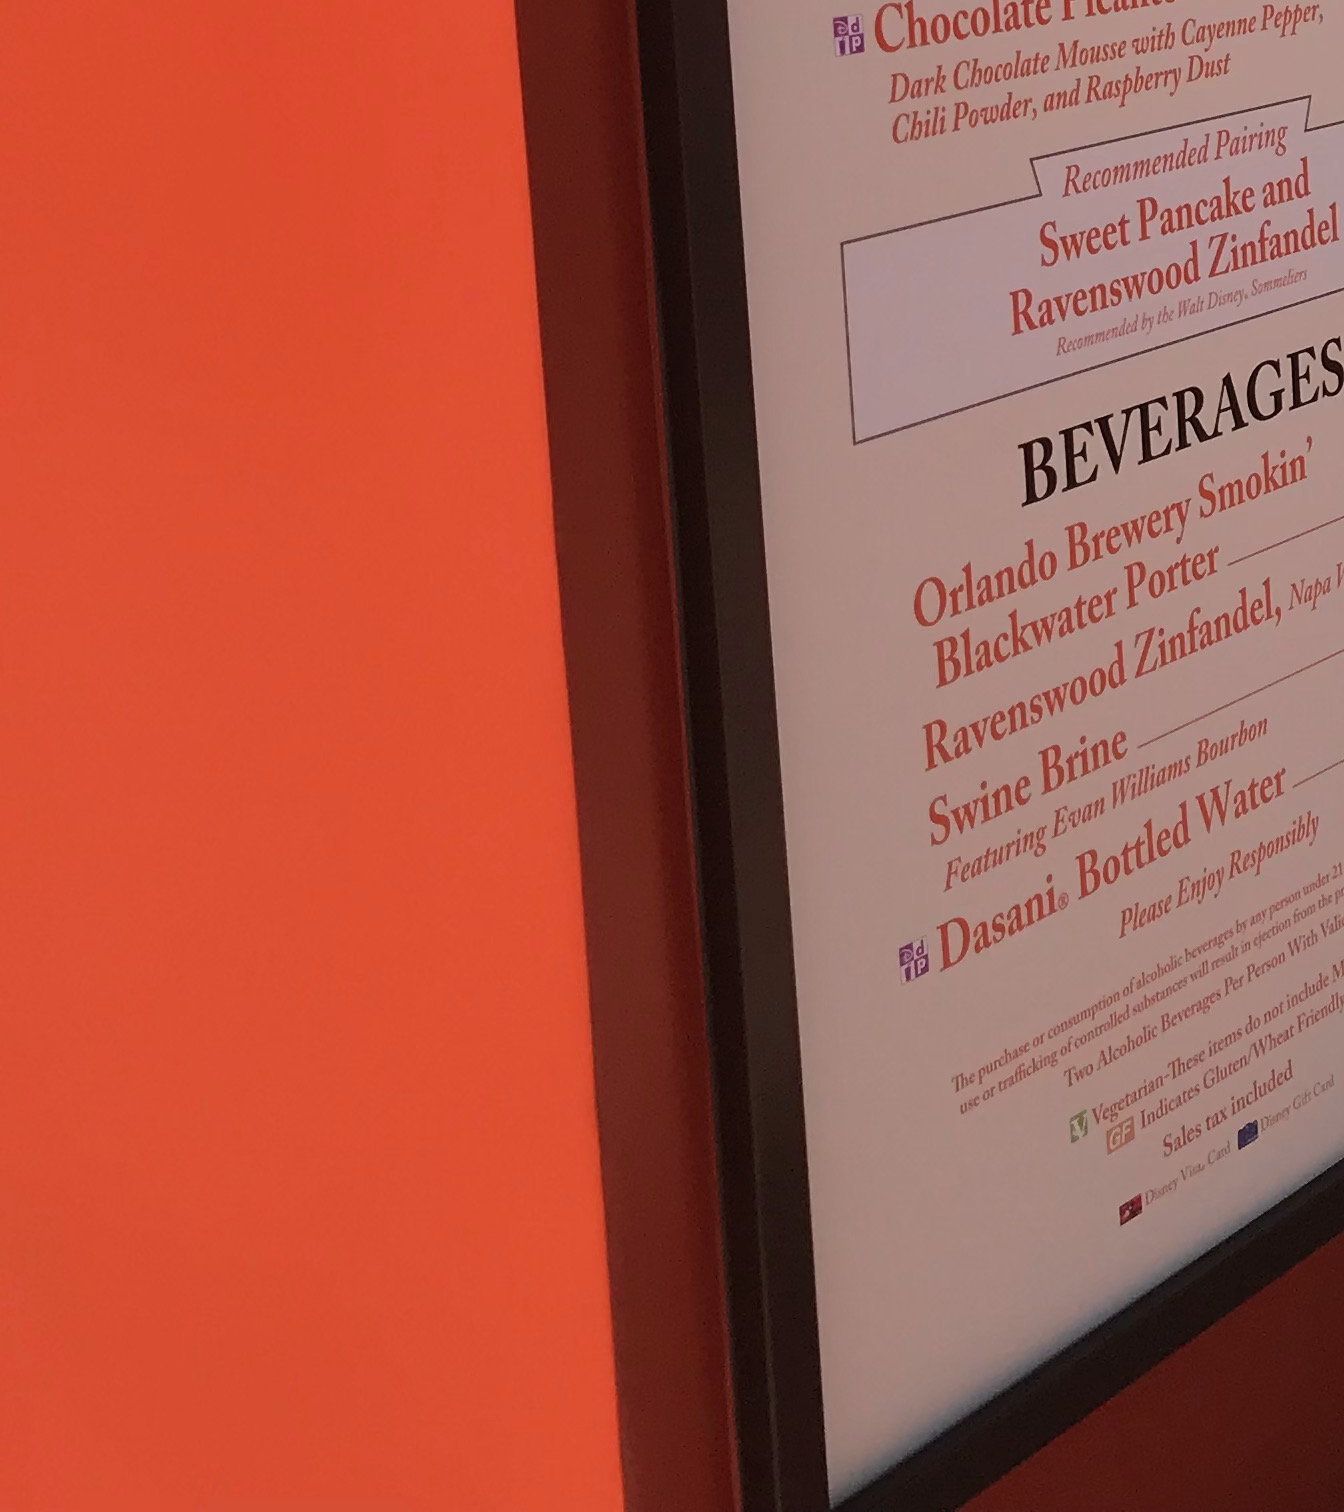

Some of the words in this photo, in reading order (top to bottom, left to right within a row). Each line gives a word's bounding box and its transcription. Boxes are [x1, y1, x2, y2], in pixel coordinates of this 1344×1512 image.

[887, 63, 948, 105] Dark
[952, 49, 1051, 91] Chocolate
[1053, 38, 1127, 72] Mousse
[1130, 21, 1176, 56] with
[1180, 14, 1257, 53] Cayenne
[1259, 2, 1324, 39] Pepper,
[891, 105, 947, 145] Chili
[951, 90, 1038, 133] Powder,
[1042, 76, 1082, 113] and
[1083, 64, 1182, 109] Raspberry
[1184, 51, 1232, 83] Dust
[1038, 212, 1132, 268] Sweet
[1135, 174, 1257, 243] Pancake
[1261, 155, 1312, 209] and
[1061, 131, 1211, 199] Recommended
[1212, 120, 1289, 161] Pairing
[1008, 238, 1202, 337] Ravenswood
[1206, 200, 1340, 279] Zinfandel
[1055, 312, 1140, 357] Recommended
[1140, 311, 1155, 336] by
[1155, 304, 1175, 326] the
[1176, 294, 1205, 320] Walt
[1249, 267, 1308, 297] Sommeliers
[1016, 334, 1344, 508] BEVERAGES
[912, 537, 1058, 628] Orlando
[1063, 496, 1193, 572] Brewery
[931, 585, 1118, 689] Blackwater
[1122, 544, 1220, 611] Porter
[921, 638, 1128, 772] Ravenswood
[1133, 575, 1282, 680] Zinfandel,
[1287, 575, 1332, 612] Napa
[927, 774, 1033, 847] Swine
[1037, 729, 1129, 796] Brine
[943, 824, 1048, 893] Featuring
[1050, 795, 1106, 839] Evan
[1110, 753, 1192, 810] Williams
[1194, 717, 1268, 769] Bourbon
[1074, 799, 1192, 900] Bottled
[1193, 766, 1287, 835] Water
[1118, 893, 1173, 939] Please
[1174, 865, 1225, 909] Enjoy
[1227, 809, 1320, 881] Responsibly
[1062, 1062, 1095, 1088] Two
[1095, 1023, 1158, 1071] Alcoholic
[1160, 988, 1222, 1033] Beverages
[1223, 973, 1245, 998] Per
[1245, 950, 1286, 983] Person
[1286, 927, 1319, 957] With
[1207, 1026, 1243, 1058] items
[1244, 1013, 1262, 1036] do
[1262, 1000, 1285, 1025] not
[1285, 971, 1330, 1011] include
[1139, 1082, 1201, 1130] Indicates
[1202, 1023, 1295, 1090] Gluten/Wheat
[1161, 1122, 1203, 1158] Sales
[1204, 1105, 1229, 1132] tax
[1229, 1057, 1294, 1117] included
[1258, 1103, 1292, 1134] Disney
[1291, 1088, 1312, 1111] Gift
[1312, 1072, 1335, 1098] Card
